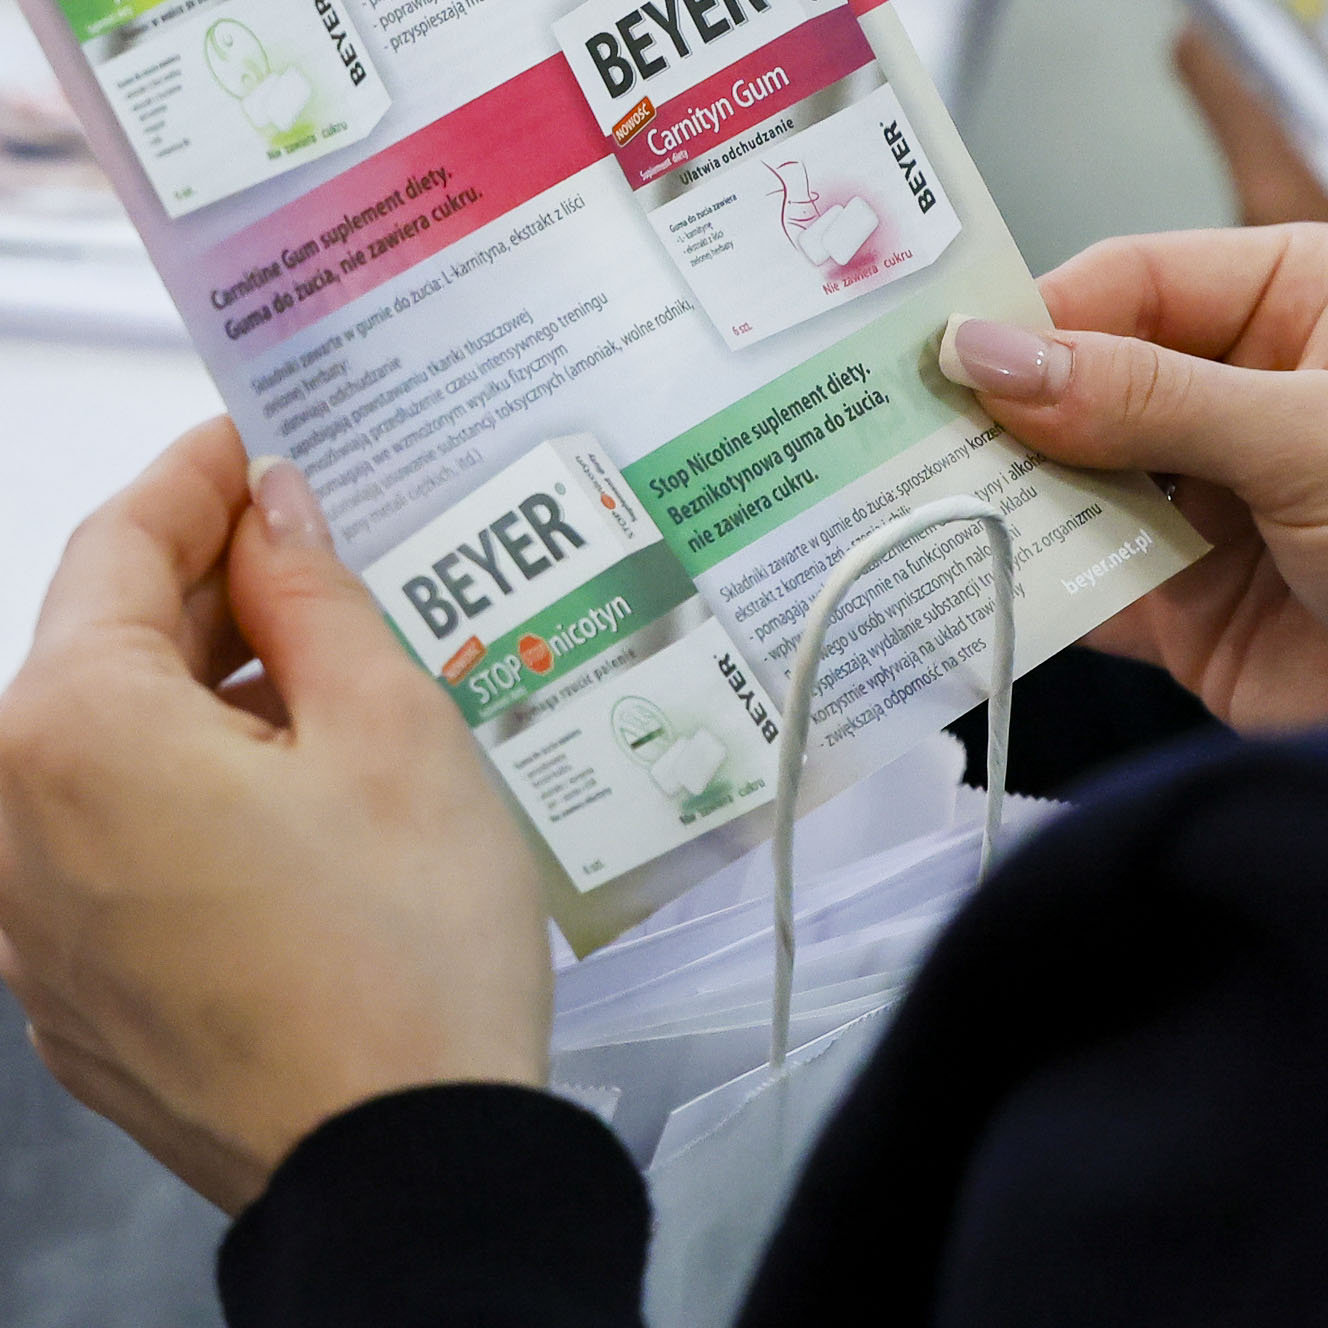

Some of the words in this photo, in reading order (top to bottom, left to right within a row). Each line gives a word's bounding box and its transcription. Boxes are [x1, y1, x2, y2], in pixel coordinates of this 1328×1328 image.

[388, 0, 467, 53] przyspieszają
[614, 102, 652, 144] NOWOŚĆ
[646, 92, 736, 158] Carnityn
[732, 64, 791, 110] Gum
[721, 117, 795, 169] odchudzanie
[885, 118, 938, 215] BEYER
[209, 260, 282, 311] Carnitine
[280, 239, 320, 270] Gum
[318, 189, 405, 250] suplement
[404, 166, 452, 200] diety.
[508, 212, 555, 246] ekstrakt
[559, 192, 585, 215] liści
[223, 304, 272, 341] Guma
[271, 291, 295, 314] do
[293, 268, 341, 302] żucia,
[338, 249, 368, 275] nie
[365, 213, 430, 260] zawiera
[430, 186, 483, 222] cukru.
[822, 280, 840, 297] Nie
[883, 248, 913, 272] cukru
[648, 467, 690, 499] Stop
[685, 430, 753, 476] Nicotine
[750, 384, 828, 440] suplement
[826, 362, 871, 395] diety.
[666, 450, 784, 526] Beznikotynowa
[782, 425, 826, 463] guma
[823, 412, 845, 433] do
[842, 389, 890, 422] żucia,
[686, 528, 715, 553] nie
[712, 494, 773, 538] zawiera
[771, 468, 819, 502] cukru.
[718, 564, 770, 603] Składniki
[766, 542, 810, 575] zawarte
[807, 535, 820, 549] w
[818, 516, 853, 547] gumie
[851, 507, 868, 523] do
[865, 489, 898, 514] żucia:
[895, 443, 970, 496] sproszkowany
[774, 585, 785, 598] z
[779, 559, 828, 593] korzenia
[824, 545, 845, 567] żeń
[866, 617, 925, 659] wydalanie
[922, 577, 981, 624] substancji
[1040, 502, 1103, 546] organizmu
[891, 567, 910, 584] na
[1061, 523, 1159, 593] beyer.net.pl
[734, 589, 778, 623] ekstrakt
[846, 629, 859, 642] u
[856, 610, 886, 636] osób
[883, 559, 967, 618] wyniszczonych
[468, 655, 524, 706] STOP
[551, 593, 634, 658] nicotyn
[865, 650, 923, 689] wpływają
[917, 640, 936, 656] na
[933, 615, 968, 646] układ
[718, 652, 781, 744] BEYER
[824, 702, 887, 747] zwiększają
[882, 662, 943, 709] odporność
[940, 655, 959, 672] na
[956, 637, 987, 662] stres
